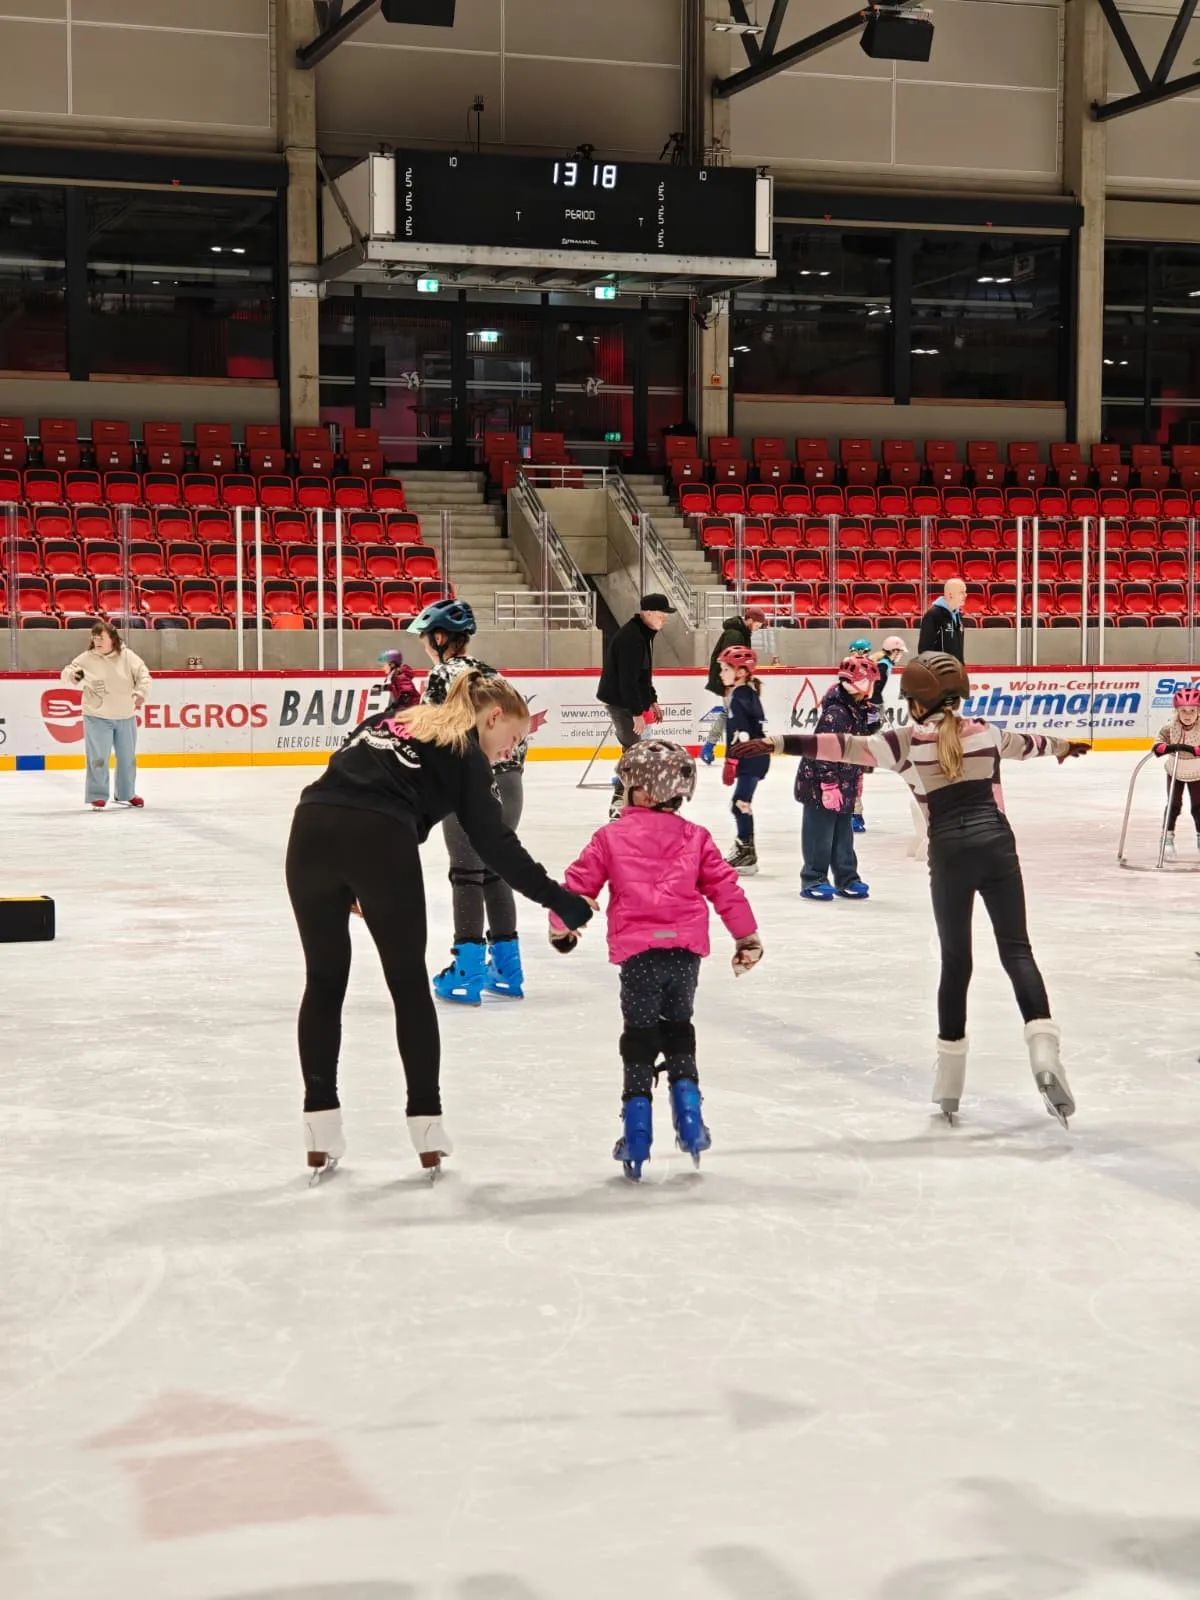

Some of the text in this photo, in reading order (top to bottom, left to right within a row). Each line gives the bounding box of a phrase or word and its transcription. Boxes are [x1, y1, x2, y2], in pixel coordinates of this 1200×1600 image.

[553, 162, 617, 188] 13 18
[565, 209, 596, 220] PERIOD
[1009, 680, 1140, 691] Wohn-Centrum
[963, 683, 1142, 717] ührmann
[1015, 717, 1135, 729] an der Saline
[571, 728, 594, 737] direkt
[277, 736, 320, 748] ENERGIE
